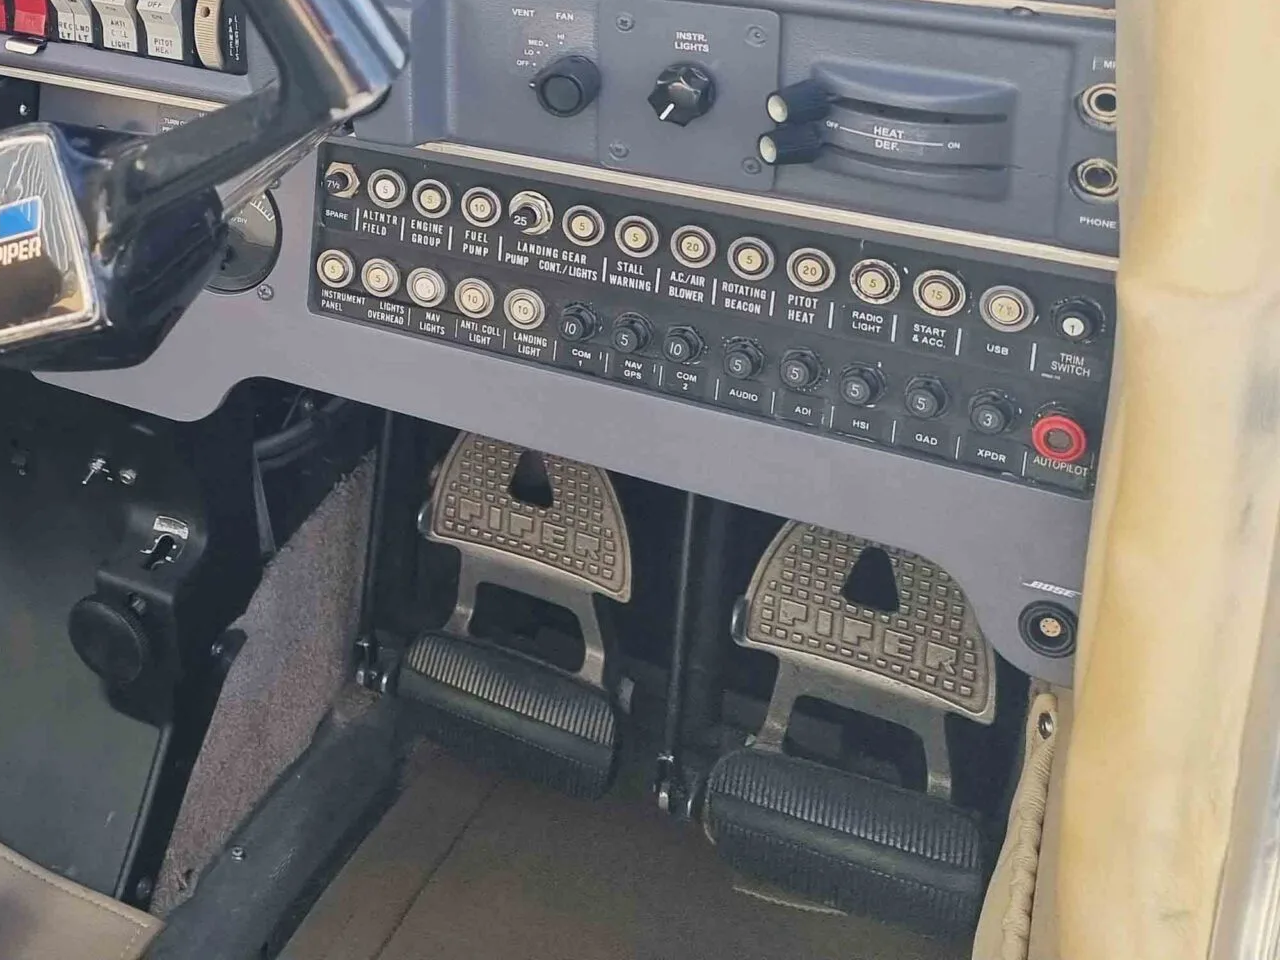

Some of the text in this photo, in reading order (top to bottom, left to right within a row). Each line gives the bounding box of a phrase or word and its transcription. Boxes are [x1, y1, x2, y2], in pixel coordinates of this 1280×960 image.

[512, 8, 535, 18] VENT
[556, 12, 574, 21] FAN
[676, 32, 708, 42] INSTR.
[675, 42, 710, 53] LIGHTS
[826, 120, 840, 130] OFF
[873, 126, 905, 140] HEAT
[874, 138, 900, 152] DEF.
[947, 142, 961, 150] ON
[325, 209, 348, 220] SPARE
[363, 210, 398, 225] ALTNTR
[513, 215, 528, 226] 25
[362, 223, 387, 236] FIELD
[411, 219, 443, 234] ENGINE
[412, 233, 441, 247] GROUP
[465, 230, 488, 243] FUEL
[463, 243, 489, 257] PUMP
[517, 241, 587, 264] LANDING GEAR
[687, 242, 699, 252] 20
[505, 252, 529, 266] PUMP
[617, 261, 644, 276] STALL
[803, 265, 817, 276] 20
[609, 274, 651, 291] WARNING
[321, 289, 366, 305] INSTRUMENT
[669, 285, 704, 303] BLOWER
[722, 281, 767, 300] ROTATING
[321, 299, 343, 312] PANEL
[380, 301, 405, 314] LIGHTS
[725, 298, 761, 314] BEACON
[788, 294, 818, 309] PITOT
[367, 310, 405, 325] OVERHEAD
[426, 311, 441, 322] NAV
[788, 308, 815, 325] HEAT
[852, 310, 883, 324] RADIO
[419, 321, 446, 335] LIGHTS
[460, 319, 501, 336] ANTI COLL
[564, 321, 577, 335] 10
[852, 321, 882, 333] LIGHT
[913, 323, 947, 338] START
[469, 332, 491, 345] LIGHT
[513, 332, 548, 347] LANDING
[912, 334, 946, 349] & ACC.
[517, 344, 541, 358] LIGHT
[670, 342, 682, 355] 10
[986, 343, 1009, 355] USB
[1059, 352, 1084, 366] TRIM
[1050, 360, 1091, 377] SWITCH
[729, 389, 758, 402] AUDIO
[794, 406, 812, 416] ADI
[852, 419, 869, 430] HSI
[983, 413, 993, 427] 3
[915, 433, 938, 445] GAD
[977, 448, 1007, 463] XPDR
[1033, 456, 1088, 477] AUTOPILOT
[457, 495, 604, 562] PIPER
[778, 597, 959, 677] PIPER
